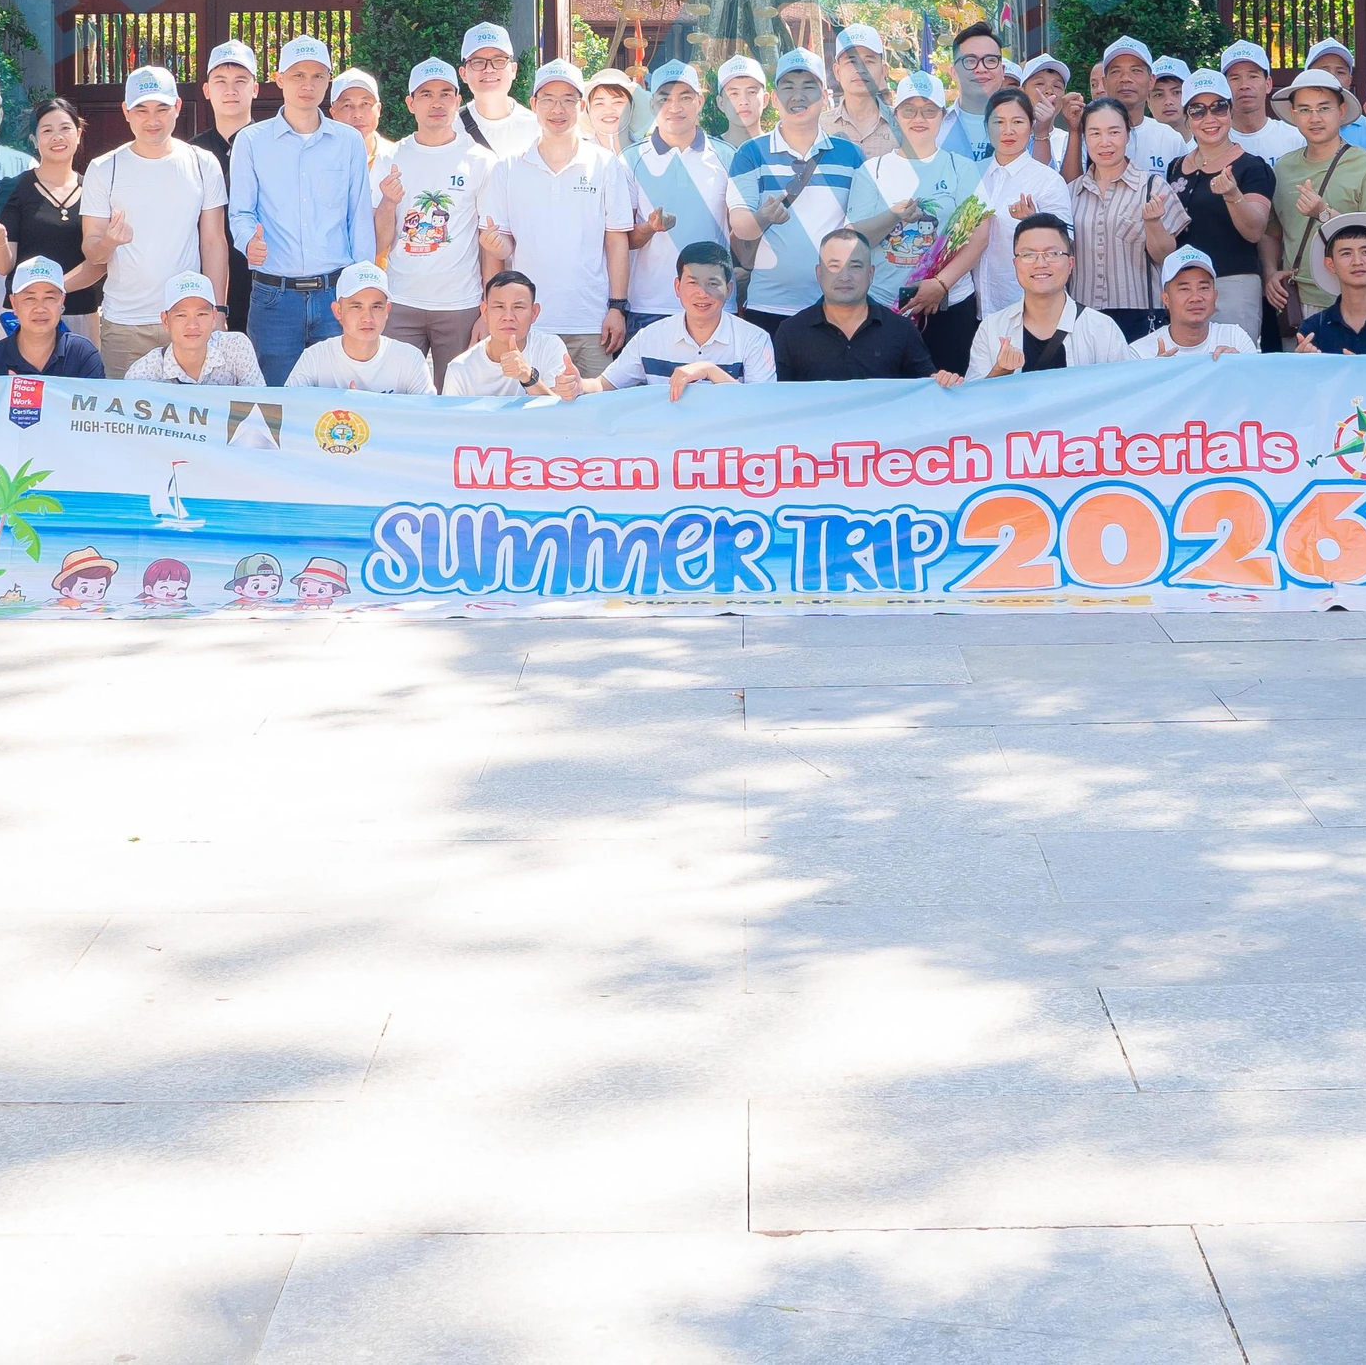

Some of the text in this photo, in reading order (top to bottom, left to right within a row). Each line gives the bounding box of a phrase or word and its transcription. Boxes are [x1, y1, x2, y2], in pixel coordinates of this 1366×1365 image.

[1150, 156, 1164, 167] 16
[450, 176, 464, 186] 16
[935, 180, 947, 190] 16
[71, 394, 209, 425] MASAN
[70, 420, 207, 442] HIGH-TECH MATERIALS
[453, 421, 1299, 499] Masan High-Tech Materials
[774, 503, 951, 594] TRIP
